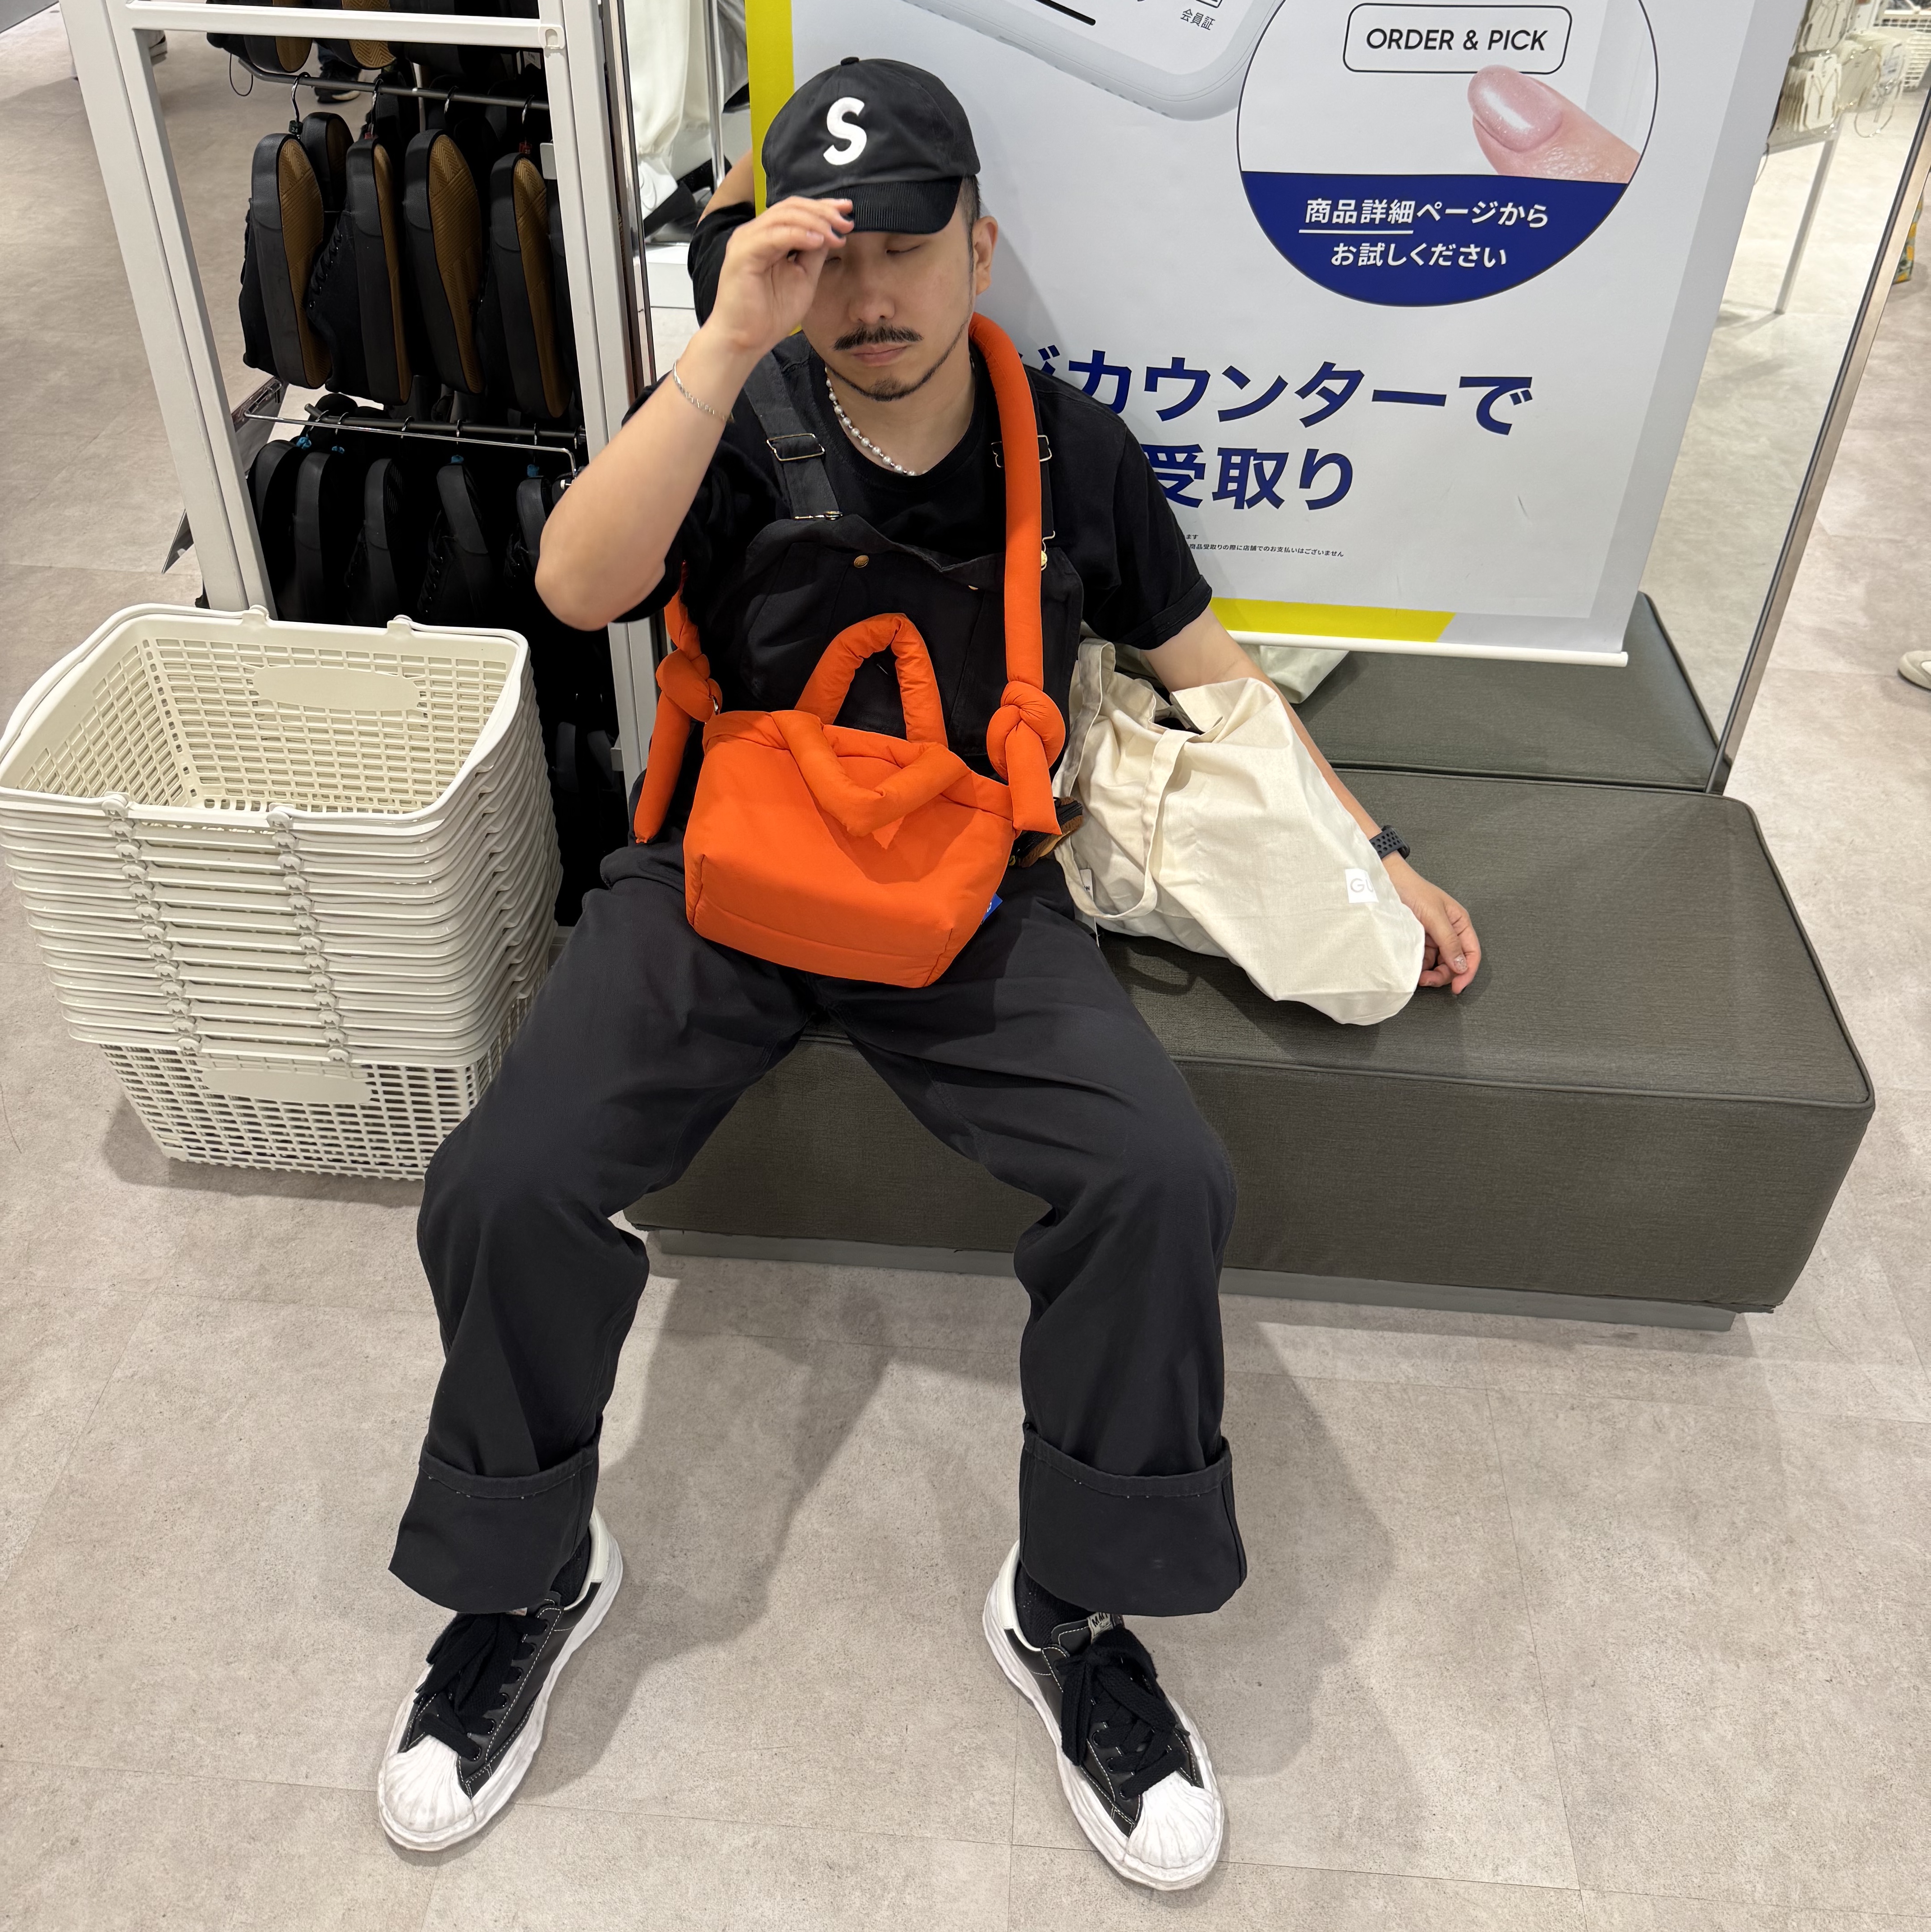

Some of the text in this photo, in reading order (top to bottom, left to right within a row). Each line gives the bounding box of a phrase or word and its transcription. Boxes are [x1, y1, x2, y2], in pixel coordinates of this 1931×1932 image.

[1180, 9, 1215, 30] 会員証
[1366, 28, 1548, 51] ORDER & PICK
[823, 97, 867, 165] S
[1305, 198, 1548, 228] 商品詳細ページから
[1331, 242, 1506, 268] お試しください
